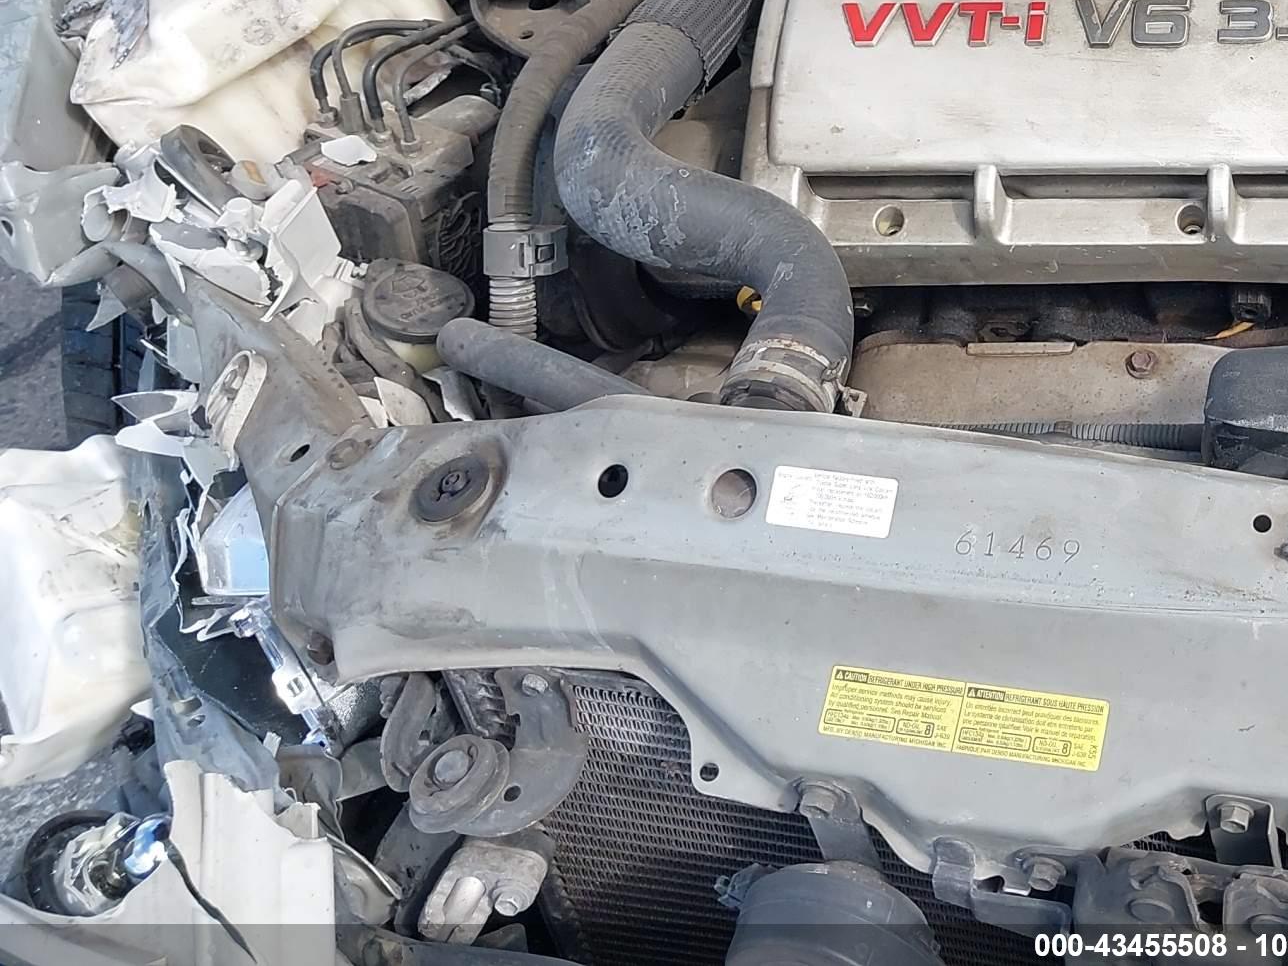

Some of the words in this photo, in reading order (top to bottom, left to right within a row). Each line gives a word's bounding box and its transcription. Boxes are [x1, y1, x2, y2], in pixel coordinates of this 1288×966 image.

[841, 1, 1050, 47] VVT-i
[955, 530, 1081, 564] 61469
[844, 671, 867, 682] CAUTION
[868, 675, 903, 686] REFRIGERANT
[903, 680, 922, 689] UNDER
[922, 682, 935, 690] HIGH
[935, 684, 962, 694] PRESSURE
[976, 689, 1004, 700] ATTENTION
[1042, 698, 1058, 706] SOUS
[1077, 702, 1104, 712] PRESSION
[924, 724, 931, 735] 8
[1060, 742, 1069, 754] 8
